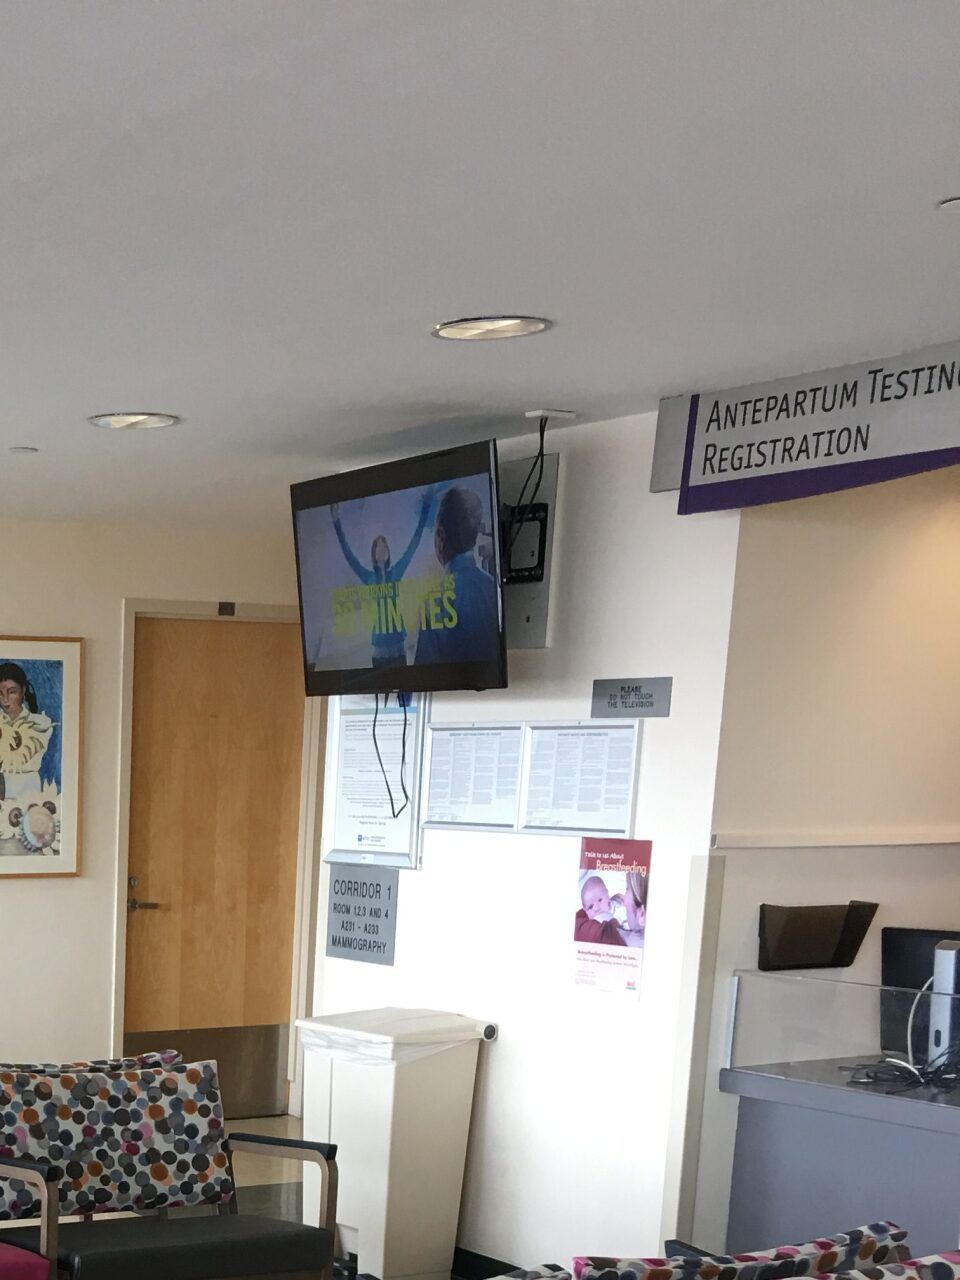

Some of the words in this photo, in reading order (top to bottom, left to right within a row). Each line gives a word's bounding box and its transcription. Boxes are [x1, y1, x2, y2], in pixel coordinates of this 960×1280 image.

[705, 379, 858, 433] ANTEPARTUM
[867, 361, 960, 405] TESTIN
[702, 424, 870, 476] REGISTRATION
[609, 693, 617, 701] DO
[635, 692, 653, 700] TOUCH
[621, 685, 642, 693] PLEASE
[607, 701, 618, 709] THE
[621, 701, 654, 709] TELEVISION
[596, 859, 647, 877] Breastfeeding
[333, 879, 382, 899] CORRIDOR
[387, 884, 392, 900] 1
[333, 902, 351, 915] ROOM
[369, 907, 381, 919] AND
[384, 908, 389, 919] 4
[341, 920, 355, 932] A231
[363, 923, 379, 935] A233
[331, 935, 387, 954] MAMMOGRAPHY
